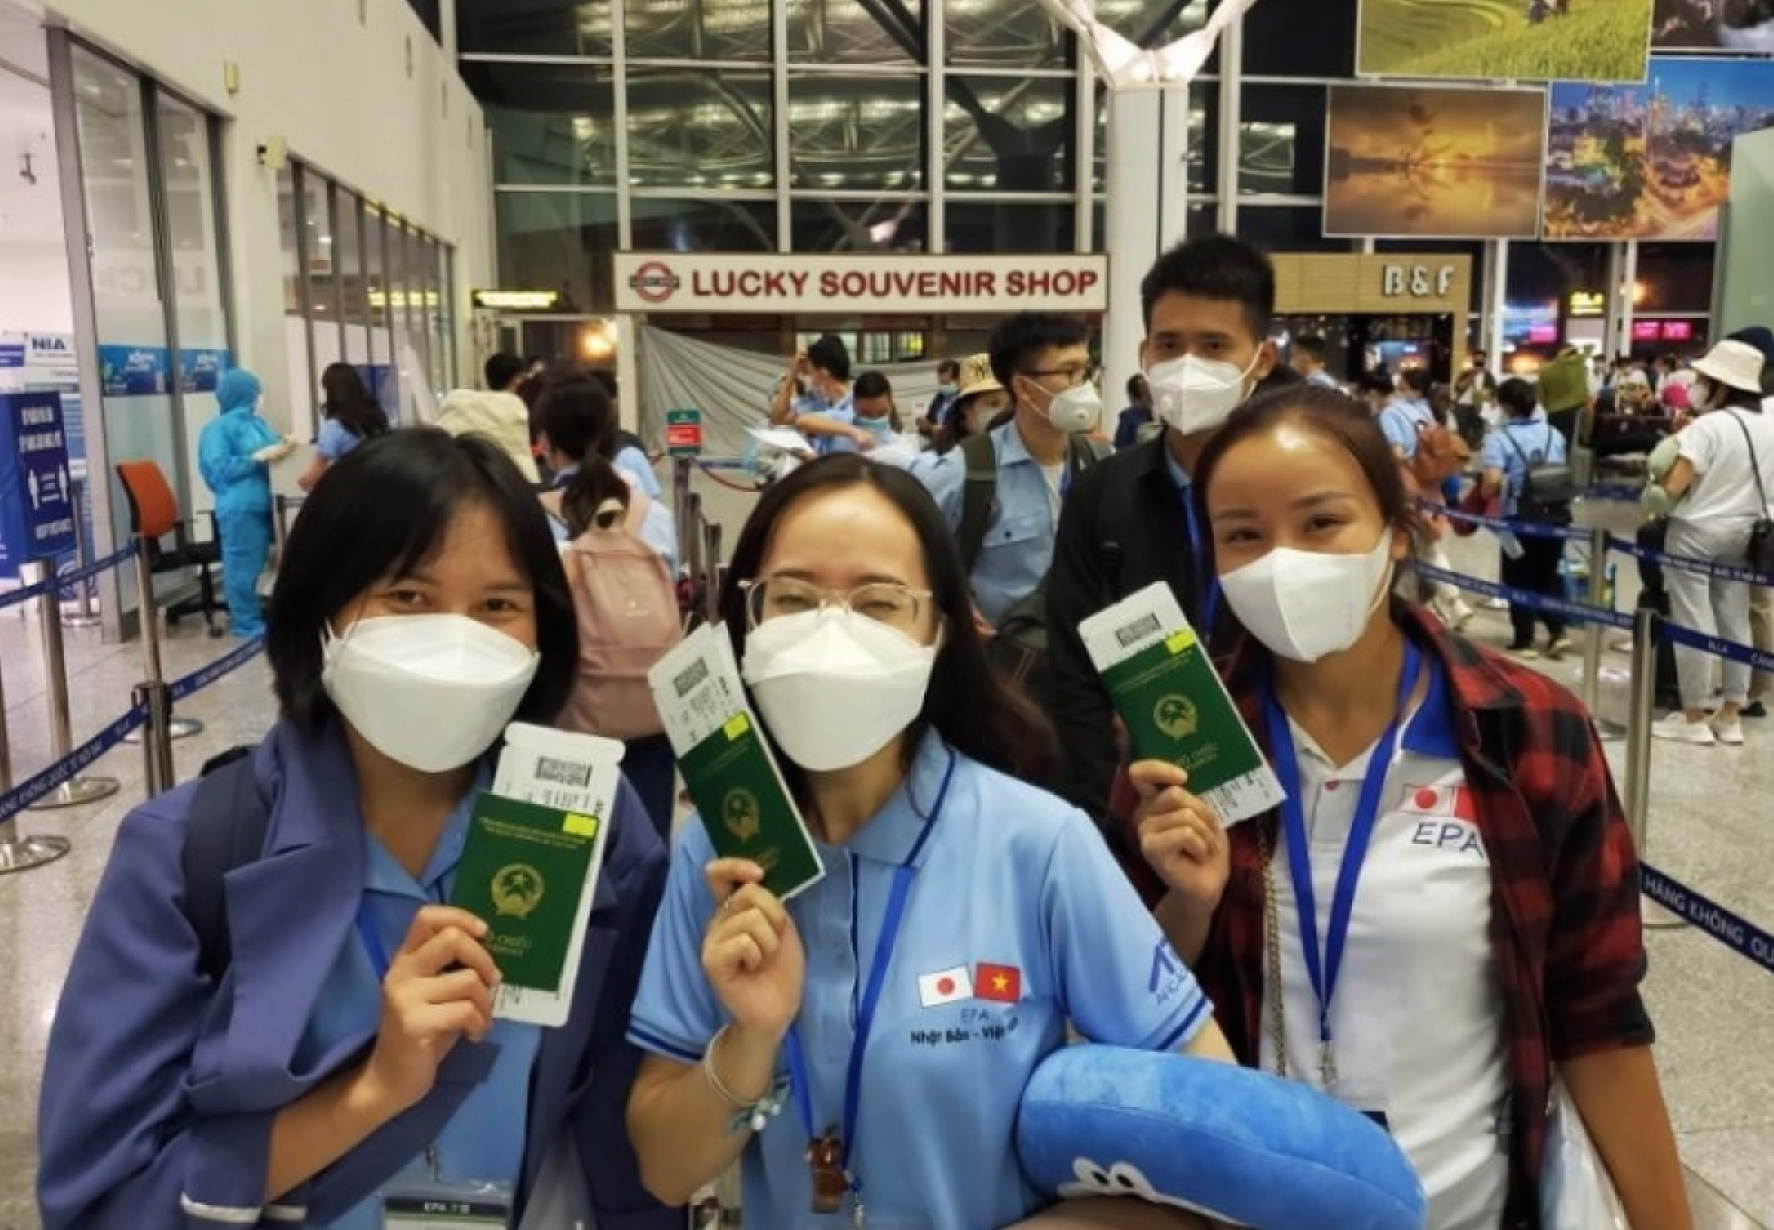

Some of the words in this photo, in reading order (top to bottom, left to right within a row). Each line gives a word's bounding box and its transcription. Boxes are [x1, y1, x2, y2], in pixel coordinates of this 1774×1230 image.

[691, 269, 809, 297] LUCKY
[819, 269, 996, 298] SOUVENIR
[1005, 268, 1099, 297] SHOP
[1411, 821, 1485, 859] EPA
